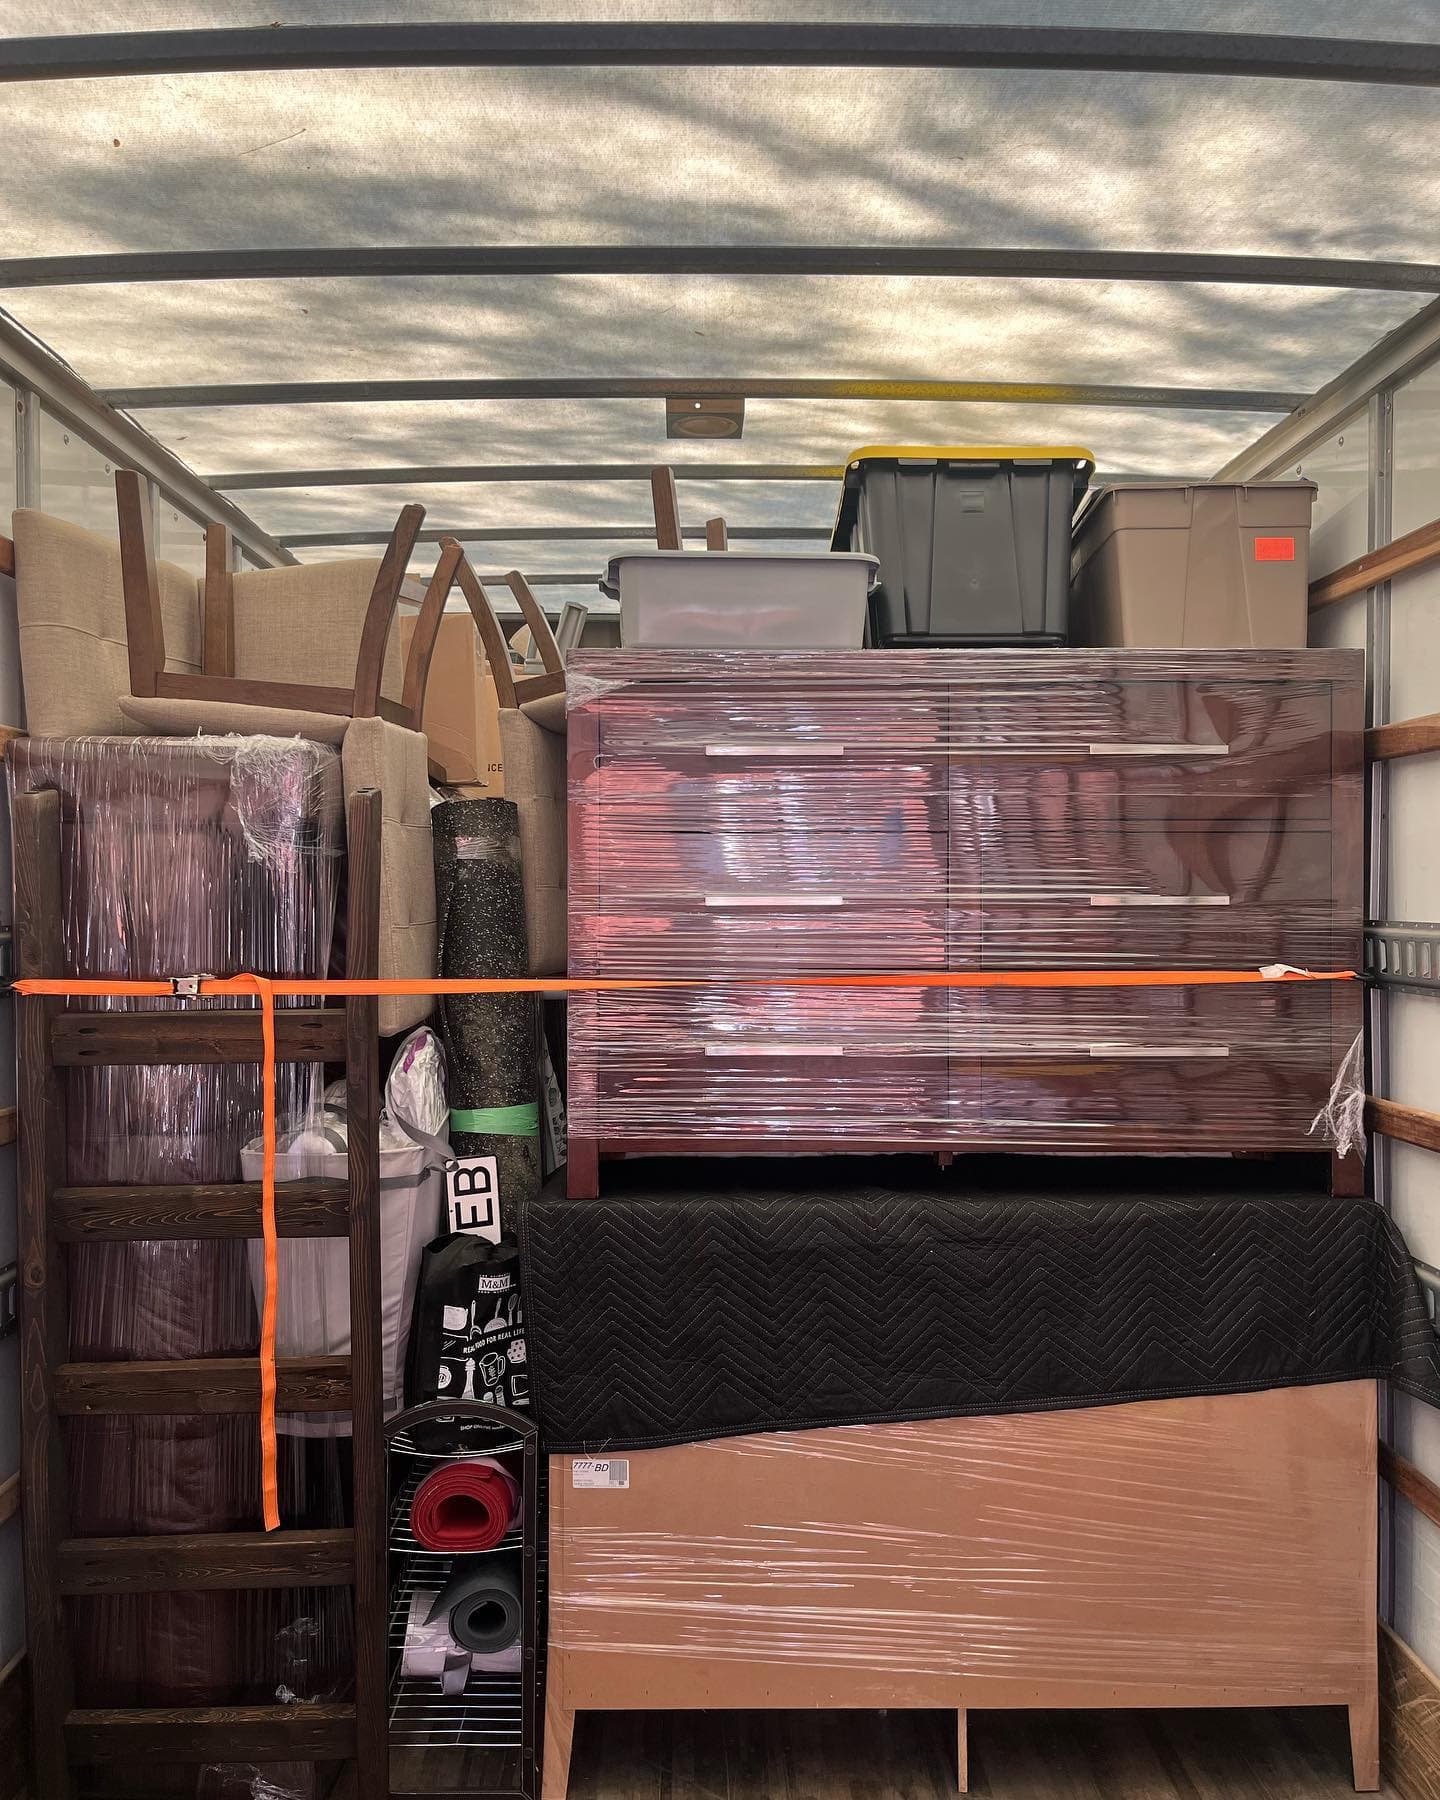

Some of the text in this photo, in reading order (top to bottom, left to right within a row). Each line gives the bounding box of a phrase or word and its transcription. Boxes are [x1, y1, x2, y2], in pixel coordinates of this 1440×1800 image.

[481, 1278, 508, 1289] M&M
[486, 1336, 497, 1344] FOR
[498, 1331, 512, 1340] REAL
[513, 1328, 525, 1336] LIFE
[574, 1462, 609, 1472] 7777-BD
